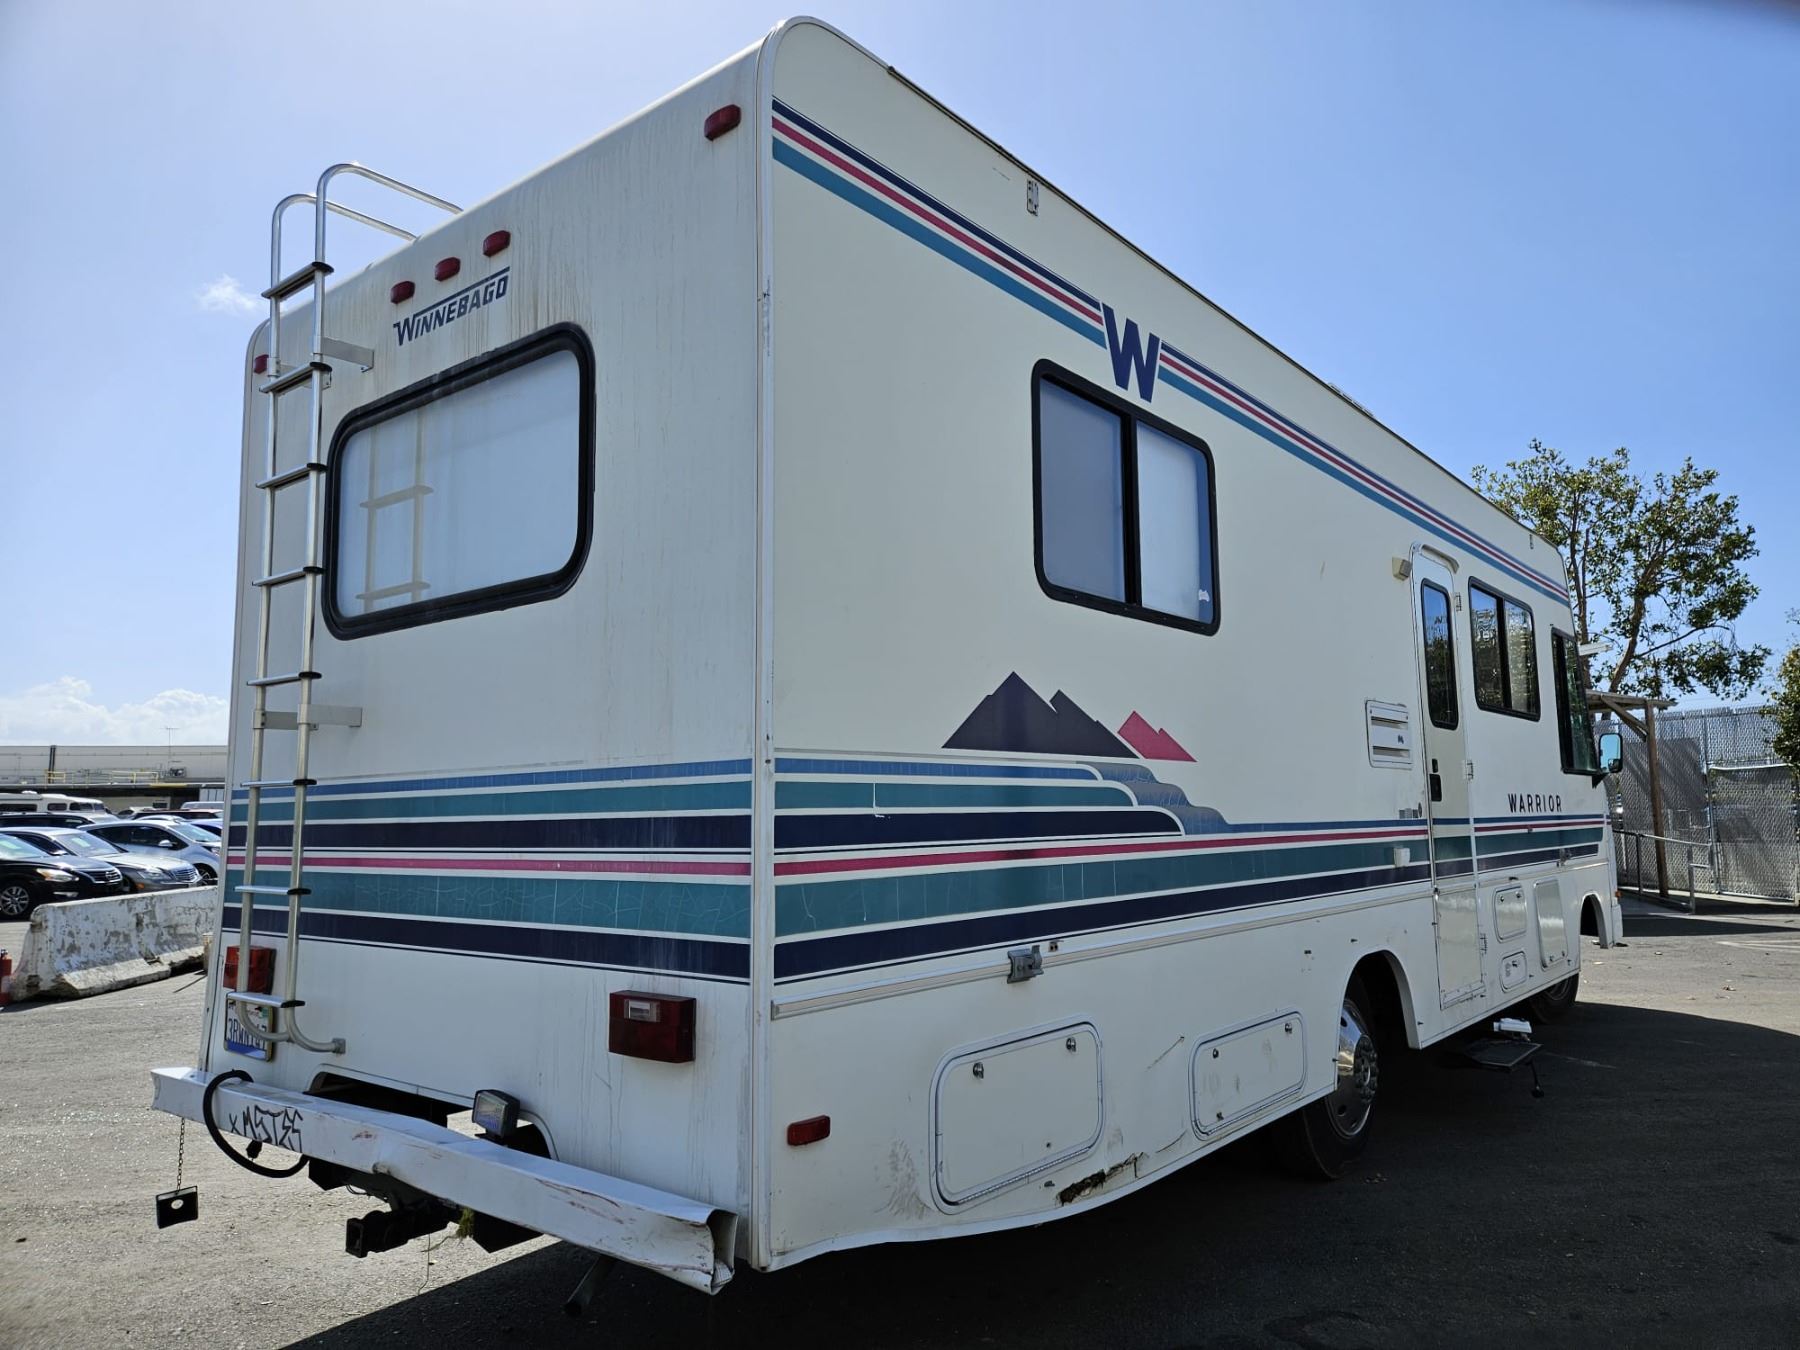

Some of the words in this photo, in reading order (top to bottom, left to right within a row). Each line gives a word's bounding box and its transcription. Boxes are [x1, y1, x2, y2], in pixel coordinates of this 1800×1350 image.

[393, 267, 510, 346] WINNEBAGO
[1102, 302, 1160, 403] W
[1507, 793, 1562, 813] WARRIOR
